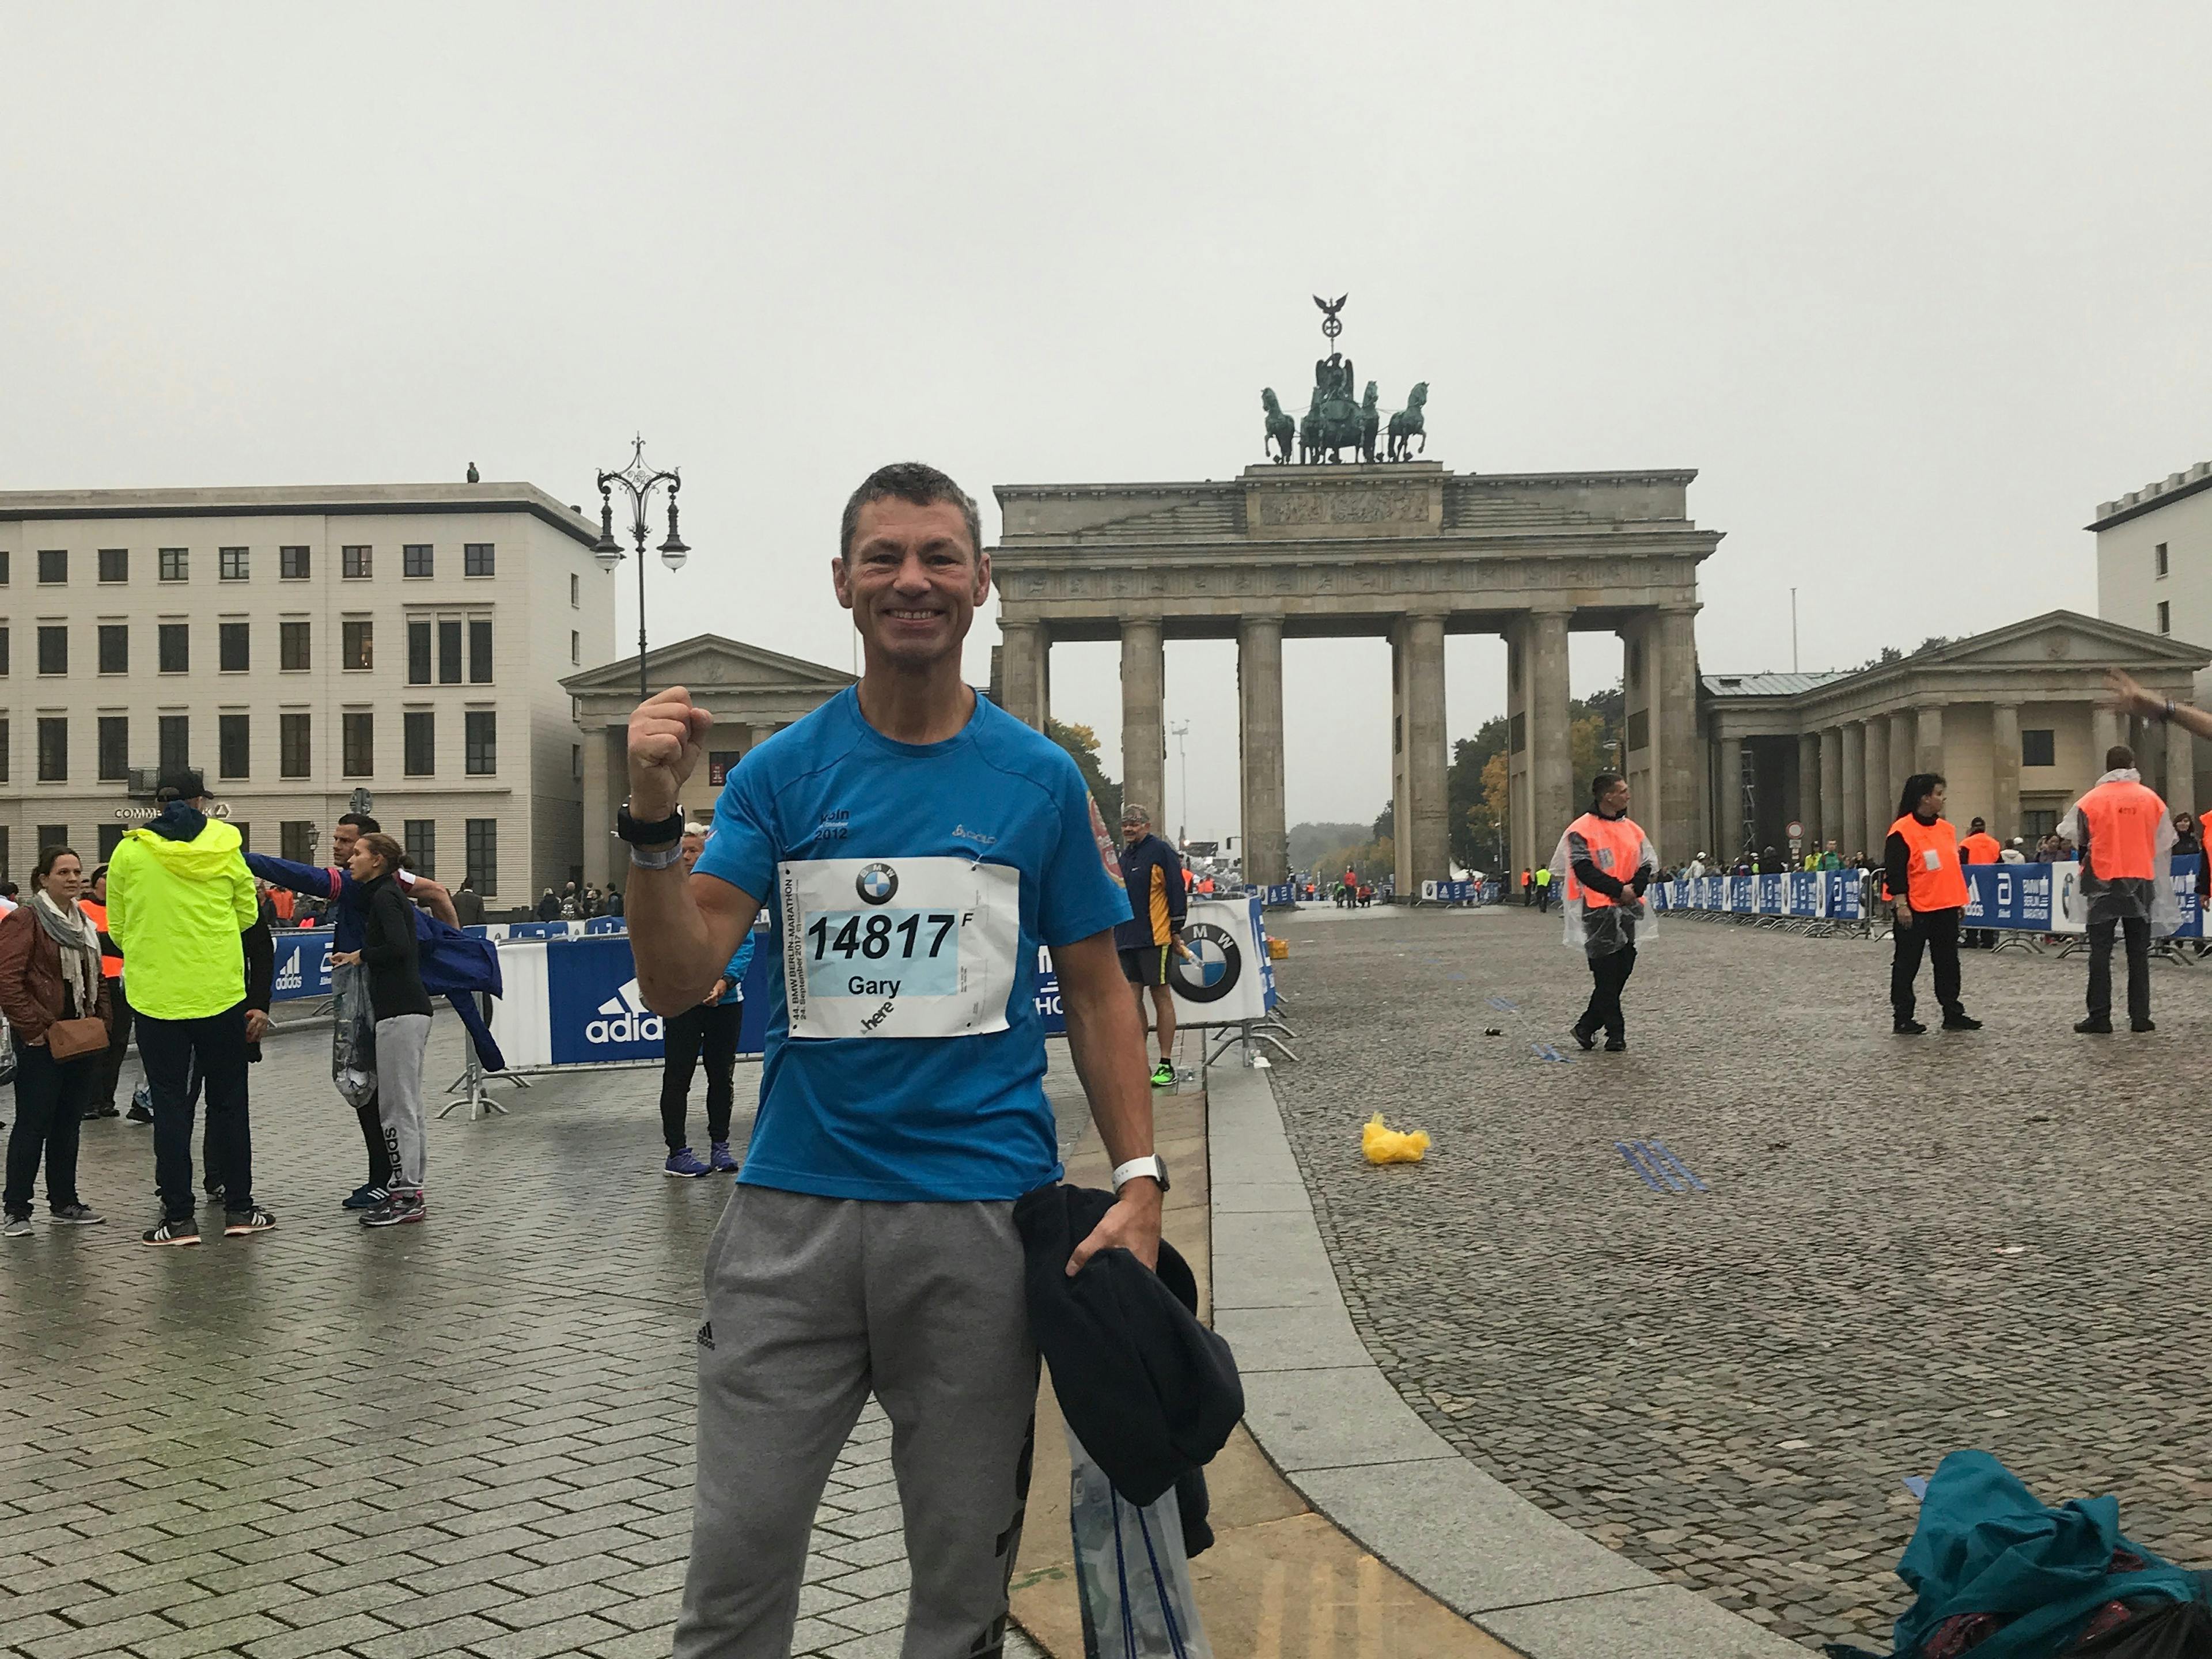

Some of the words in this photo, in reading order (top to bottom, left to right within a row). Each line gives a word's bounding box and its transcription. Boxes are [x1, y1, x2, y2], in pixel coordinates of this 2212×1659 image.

[814, 827, 848, 840] 2012
[859, 864, 895, 878] BMW
[961, 912, 974, 927] F
[795, 934, 803, 956] 2017
[808, 913, 955, 960] 14817
[1192, 925, 1234, 950] MW
[790, 979, 799, 1004] BMW
[796, 958, 807, 1005] September
[848, 975, 902, 999] Gary
[860, 1001, 895, 1031] here
